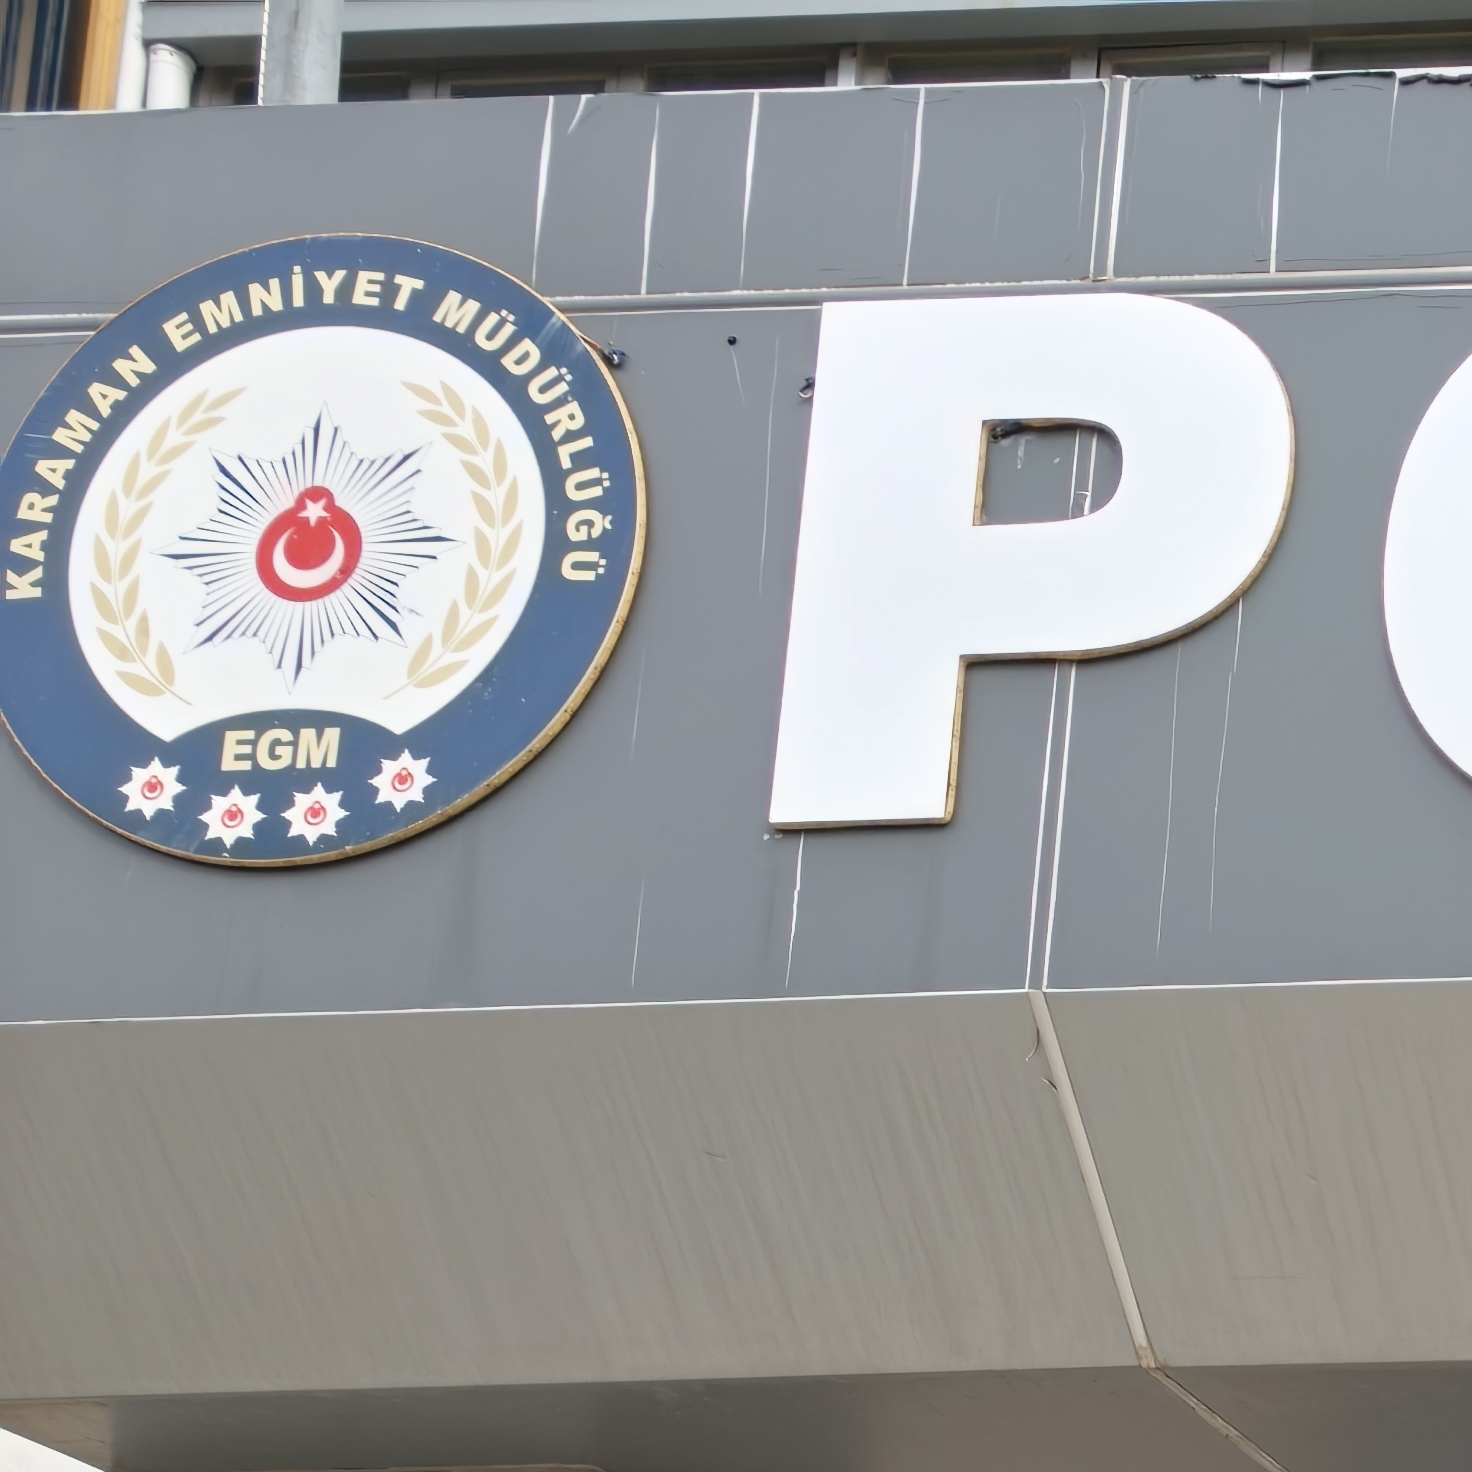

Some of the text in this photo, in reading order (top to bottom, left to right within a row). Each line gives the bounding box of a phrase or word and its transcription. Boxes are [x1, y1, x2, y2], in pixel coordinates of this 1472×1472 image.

[5, 265, 613, 600] KARAMAN EMNİYET MÜDÜRLÜĞÜ
[220, 727, 340, 771] EGM
